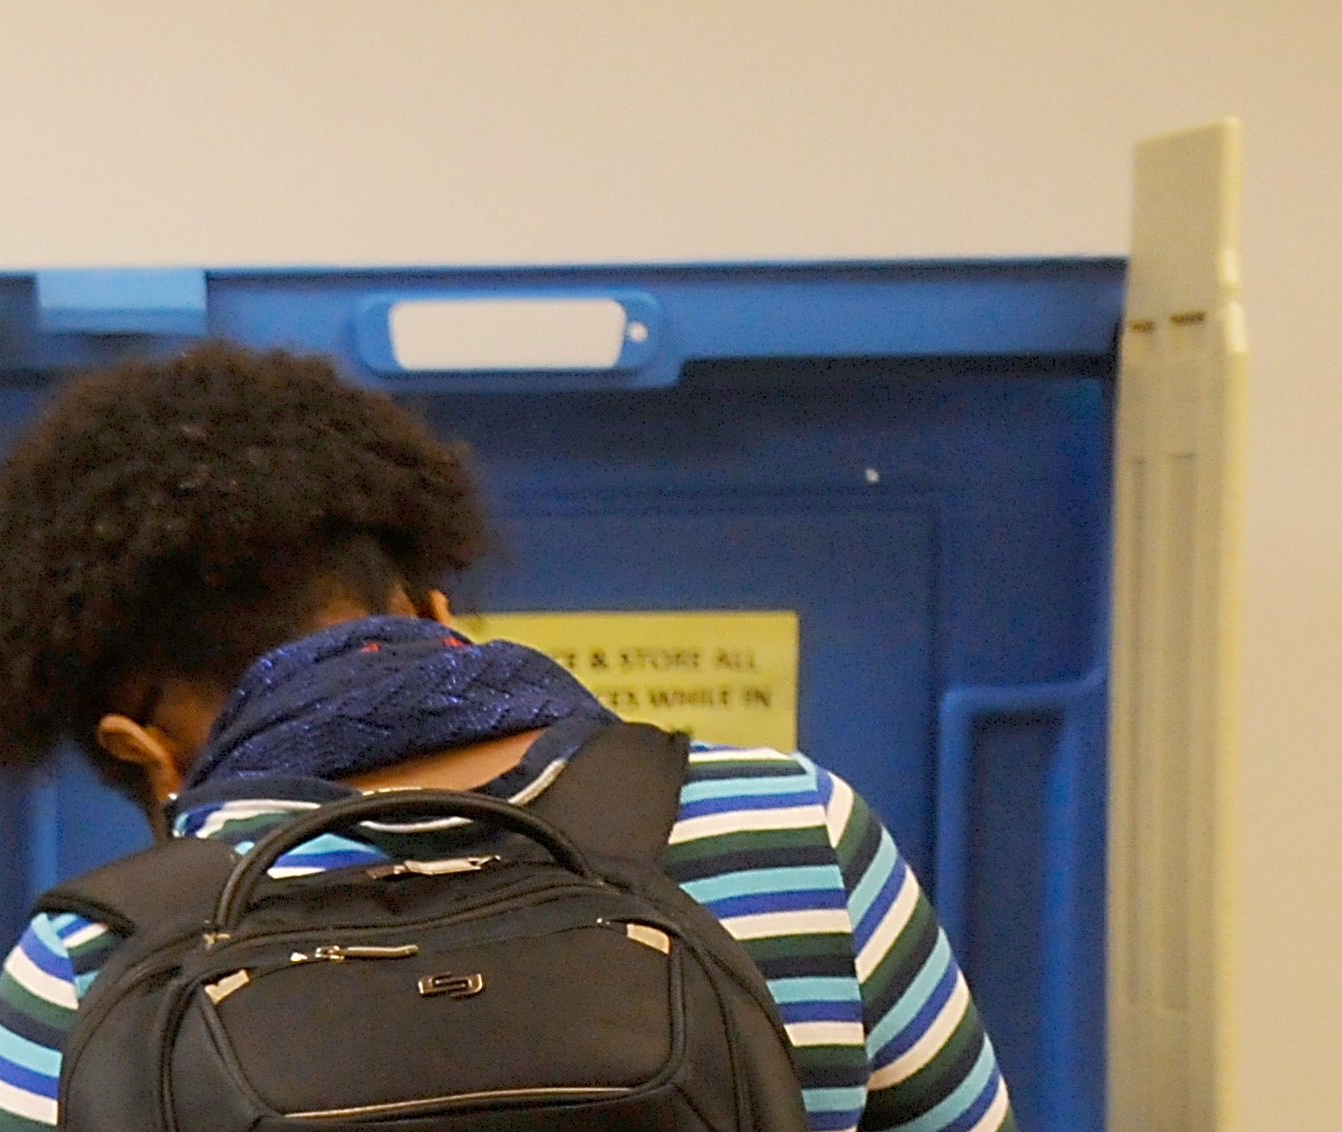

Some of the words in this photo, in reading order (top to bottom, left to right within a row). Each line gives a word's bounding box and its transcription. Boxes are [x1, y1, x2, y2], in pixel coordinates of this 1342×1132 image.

[590, 647, 609, 671] &
[620, 647, 701, 672] STORE
[714, 647, 758, 673] ALL
[742, 686, 772, 709] IN
